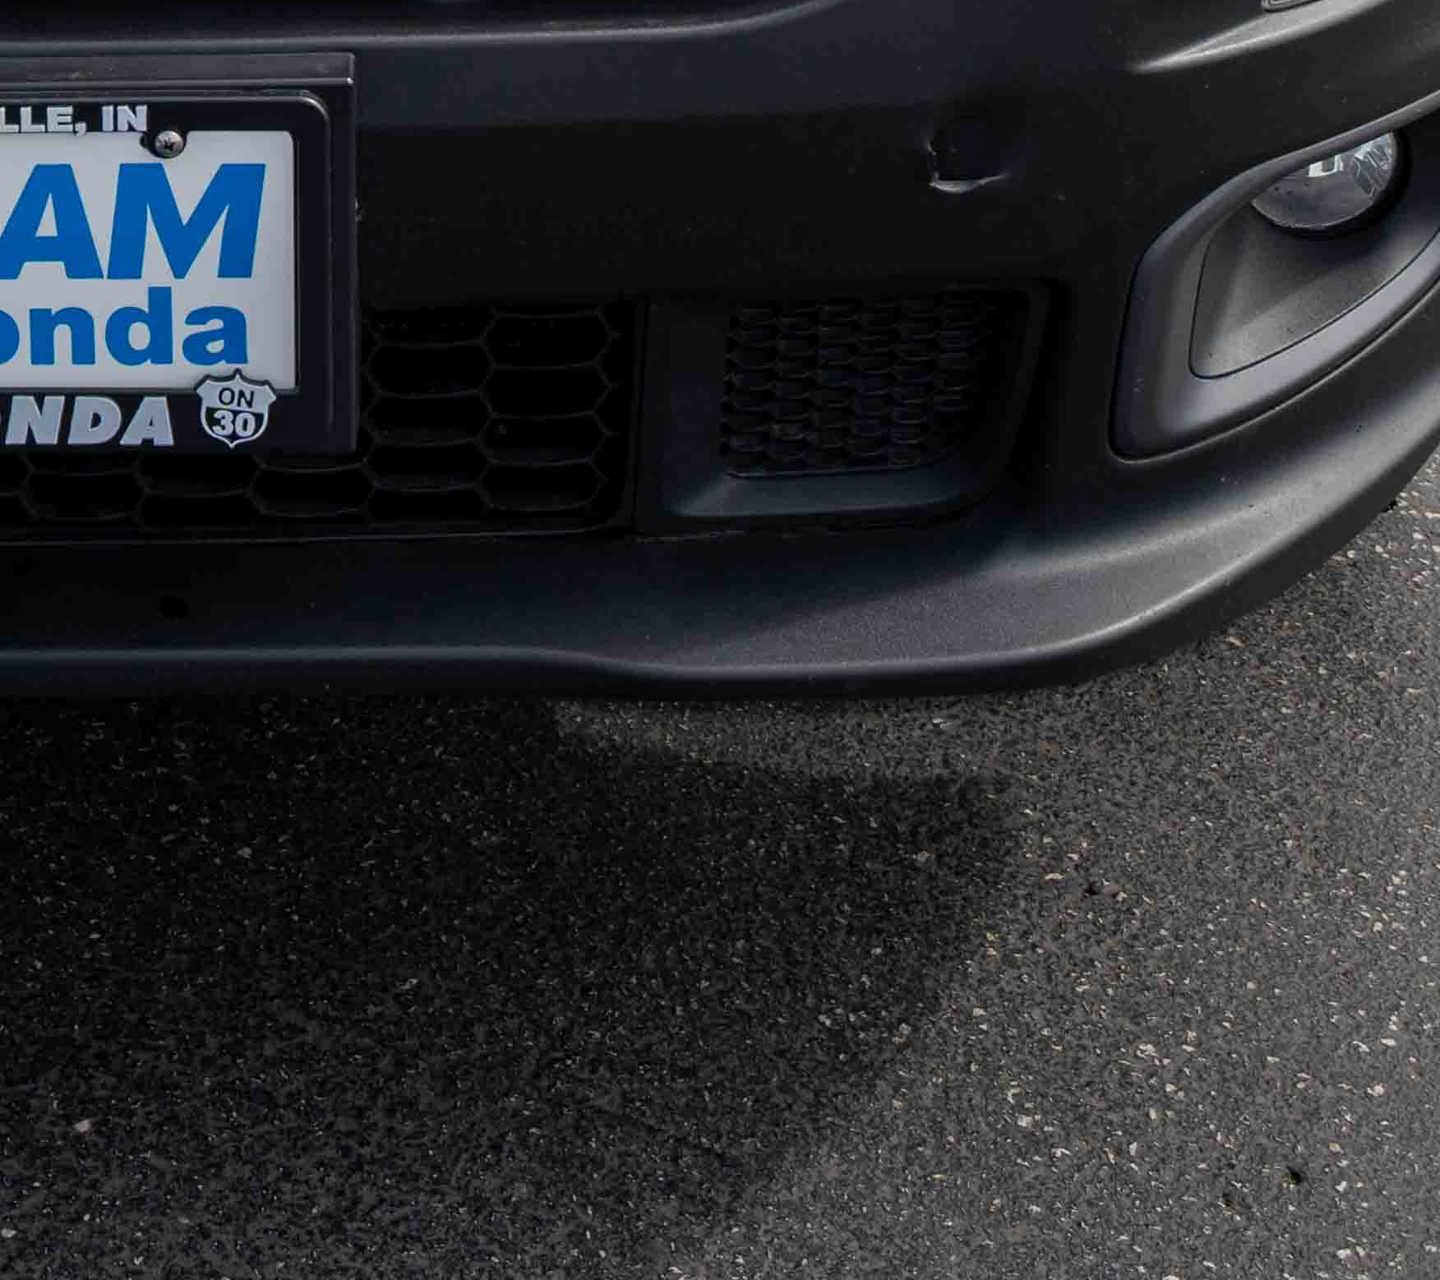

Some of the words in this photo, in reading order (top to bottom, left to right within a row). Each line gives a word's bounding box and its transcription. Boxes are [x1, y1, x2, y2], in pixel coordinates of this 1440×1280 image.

[103, 104, 148, 133] IN
[216, 386, 256, 408] ON
[210, 408, 257, 440] 30
